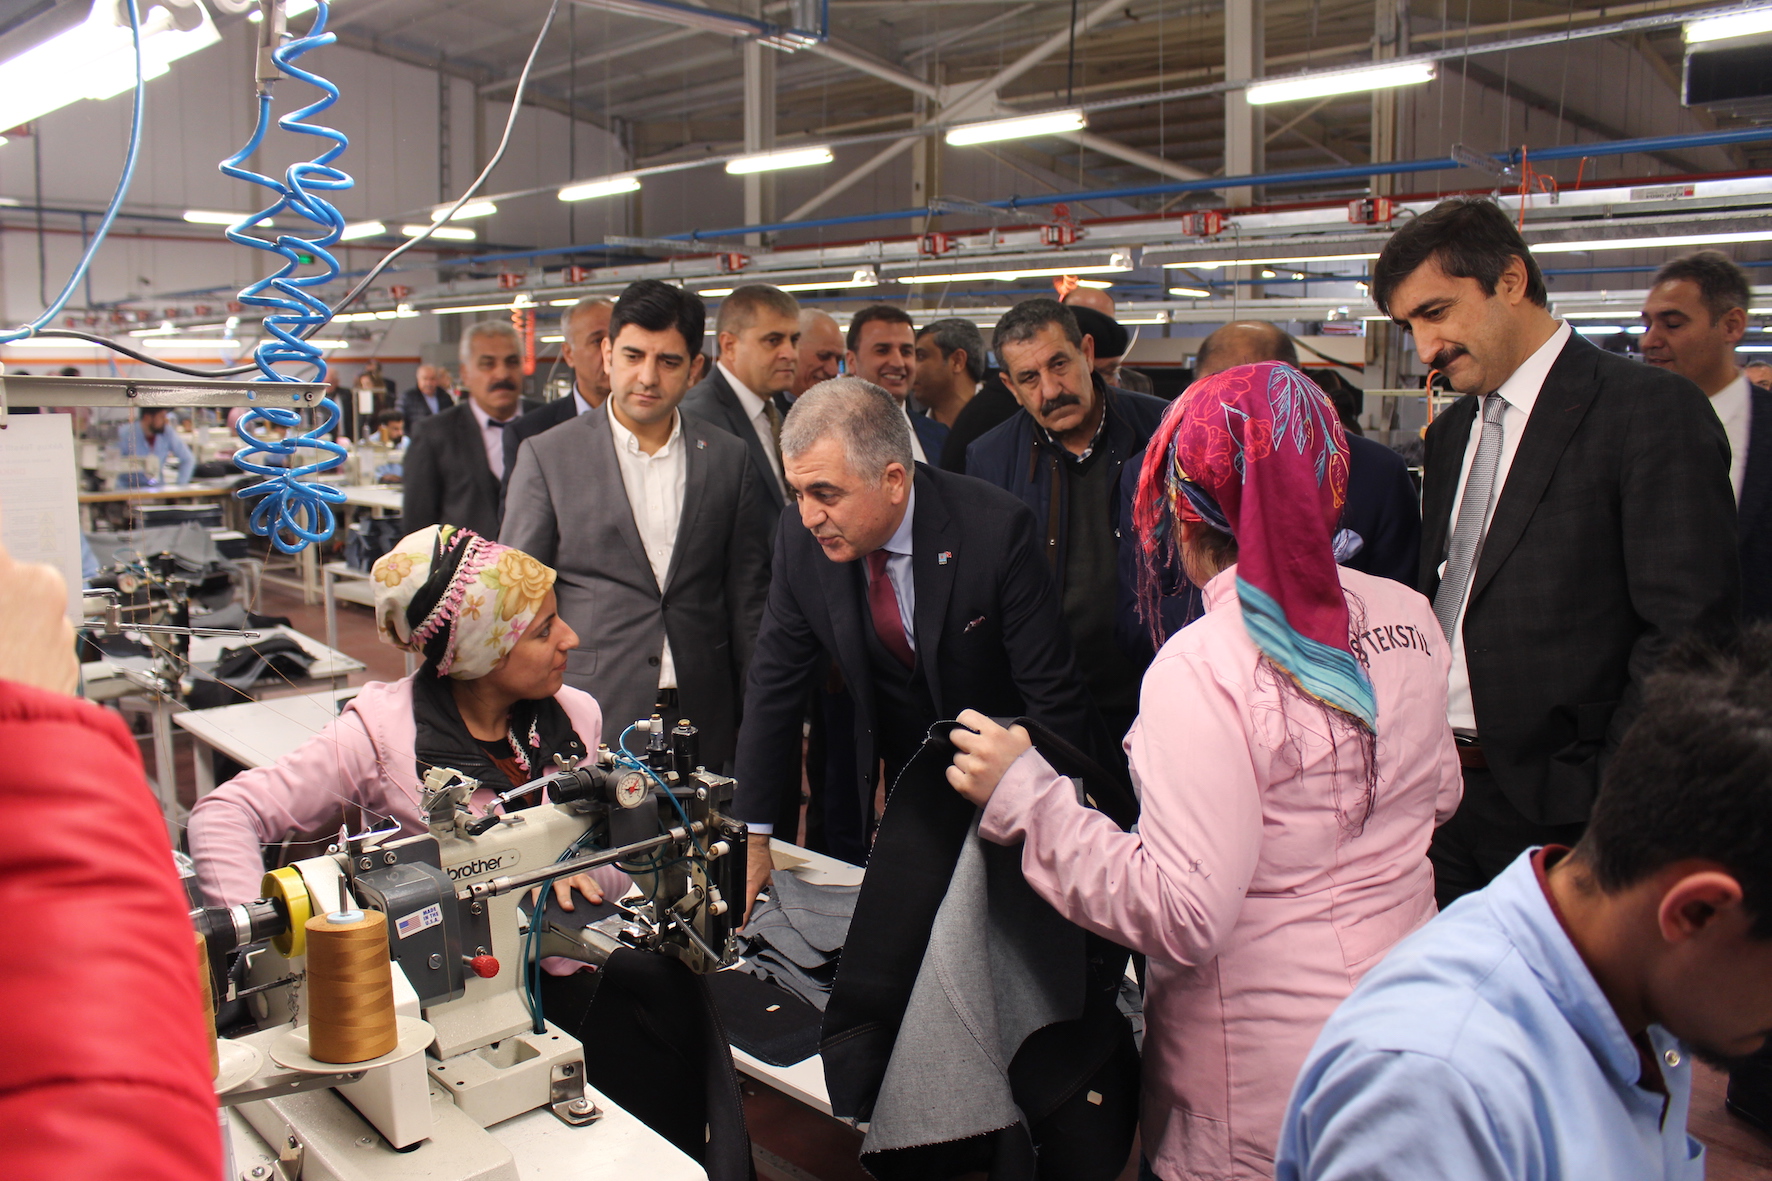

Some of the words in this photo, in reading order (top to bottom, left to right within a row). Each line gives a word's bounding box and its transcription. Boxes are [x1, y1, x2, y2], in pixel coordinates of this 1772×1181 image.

[1361, 624, 1431, 656] TEKSTİL
[447, 856, 502, 880] brother
[422, 907, 437, 915] MADE
